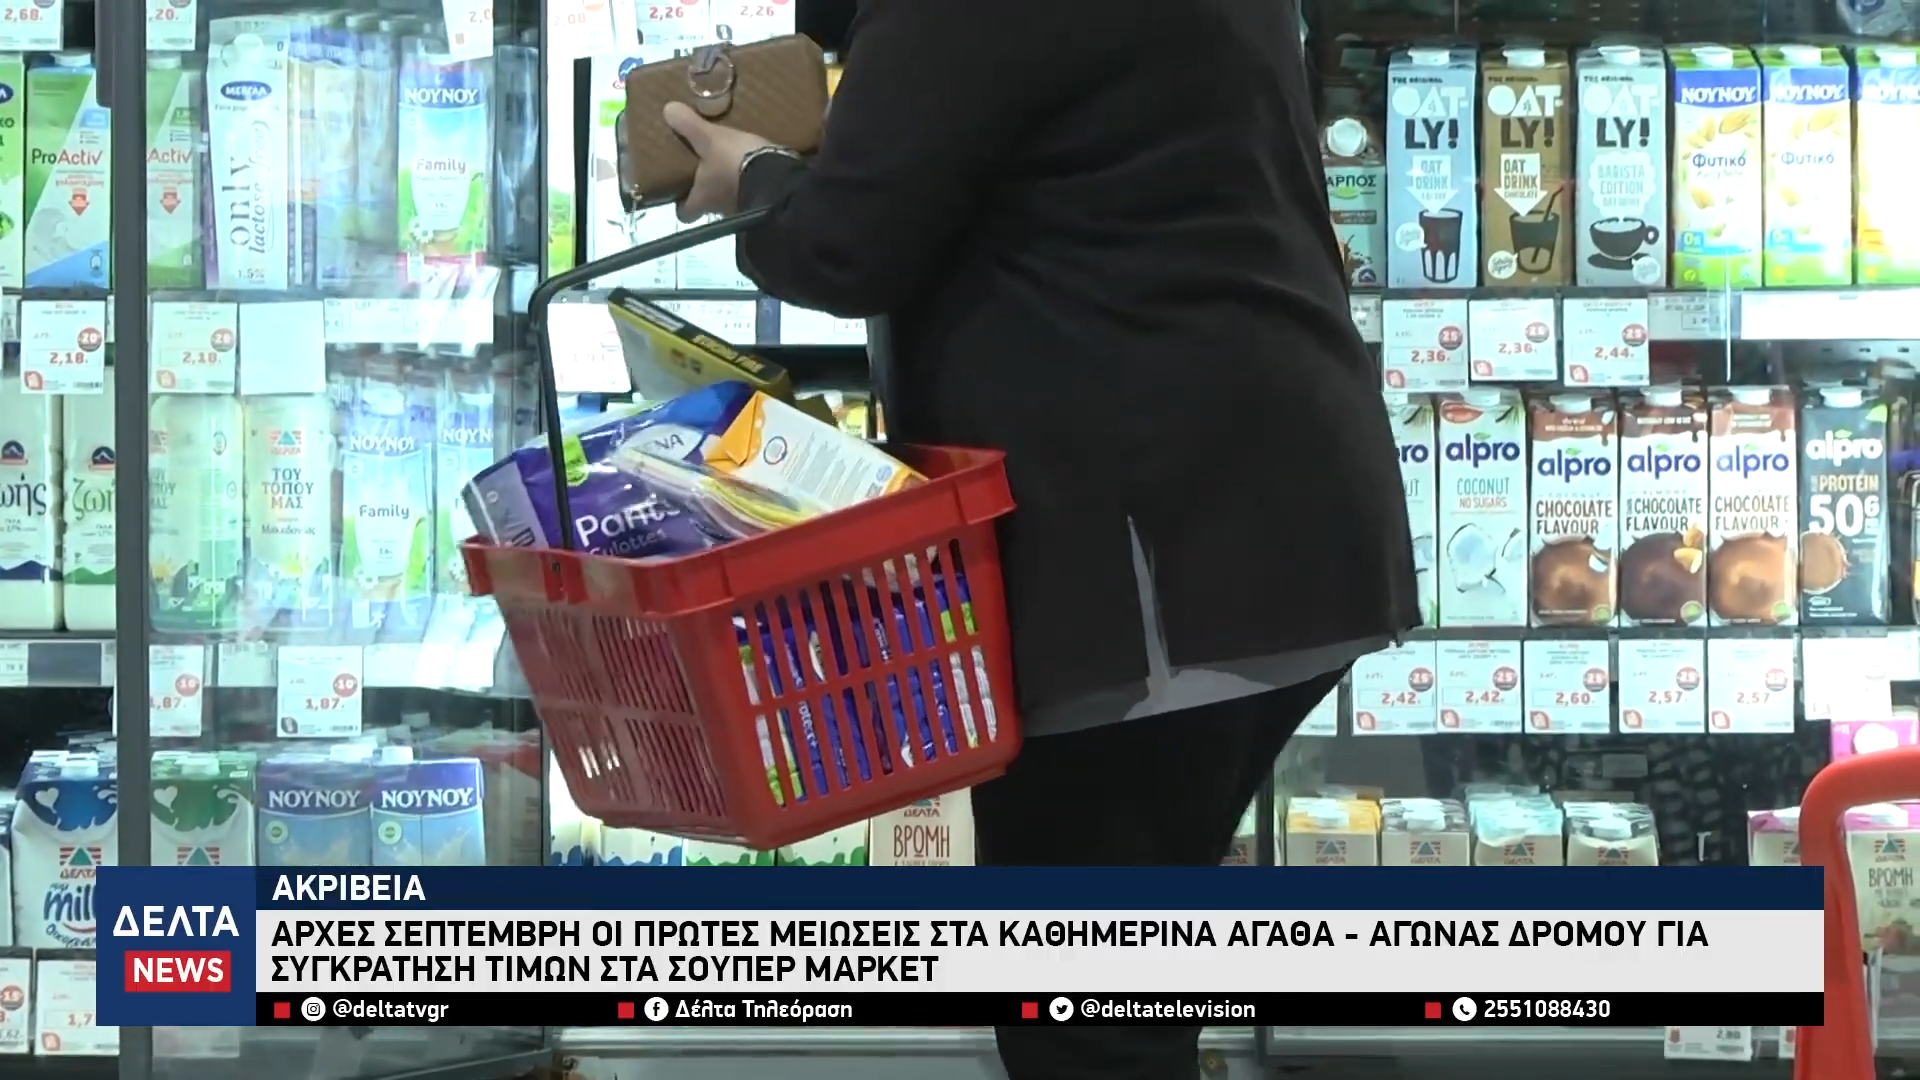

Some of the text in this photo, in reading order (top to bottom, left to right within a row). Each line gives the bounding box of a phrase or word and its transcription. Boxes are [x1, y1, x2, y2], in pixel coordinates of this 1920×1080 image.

[1405, 118, 1458, 149] LY!
[1501, 117, 1554, 148] LY!
[1597, 117, 1649, 148] LY!
[32, 148, 103, 164] ProActiv
[146, 148, 192, 164] Activ
[1692, 149, 1747, 168] Φυτικό
[417, 158, 466, 174] Family
[1421, 161, 1443, 174] OAT
[1504, 160, 1526, 173] OAT
[1598, 165, 1645, 178] BARISTA
[1416, 176, 1448, 190] DRINK
[1504, 175, 1538, 189] DRINK
[1600, 181, 1644, 195] EDITION
[222, 156, 250, 246] only
[443, 428, 493, 443] ΝΟΥΝ
[1446, 433, 1520, 468] alpro
[1806, 430, 1883, 467] alpro
[1537, 449, 1611, 483] alpro
[1627, 445, 1701, 480] alpro
[1716, 445, 1789, 479] alpro
[271, 468, 302, 481] ΤΟΥ
[261, 482, 314, 495] ΤΟΠΟΥ
[1457, 477, 1510, 495] COCONUT
[271, 496, 303, 509] ΜΑΣ
[1460, 497, 1508, 508] NO SUGARS
[1536, 500, 1613, 518] CHOCOLATE
[1634, 498, 1702, 514] CHOCOLATE
[1715, 495, 1790, 513] CHOCOLATE
[359, 505, 410, 520] Family
[1536, 519, 1599, 535] FLAVOUR
[1626, 516, 1689, 531] FLAVOUR
[1715, 516, 1779, 530] FLAVOUR
[269, 789, 361, 808] ΝΟΥΝΟΥ
[381, 788, 474, 808] ΝΟΥΝΟΥ
